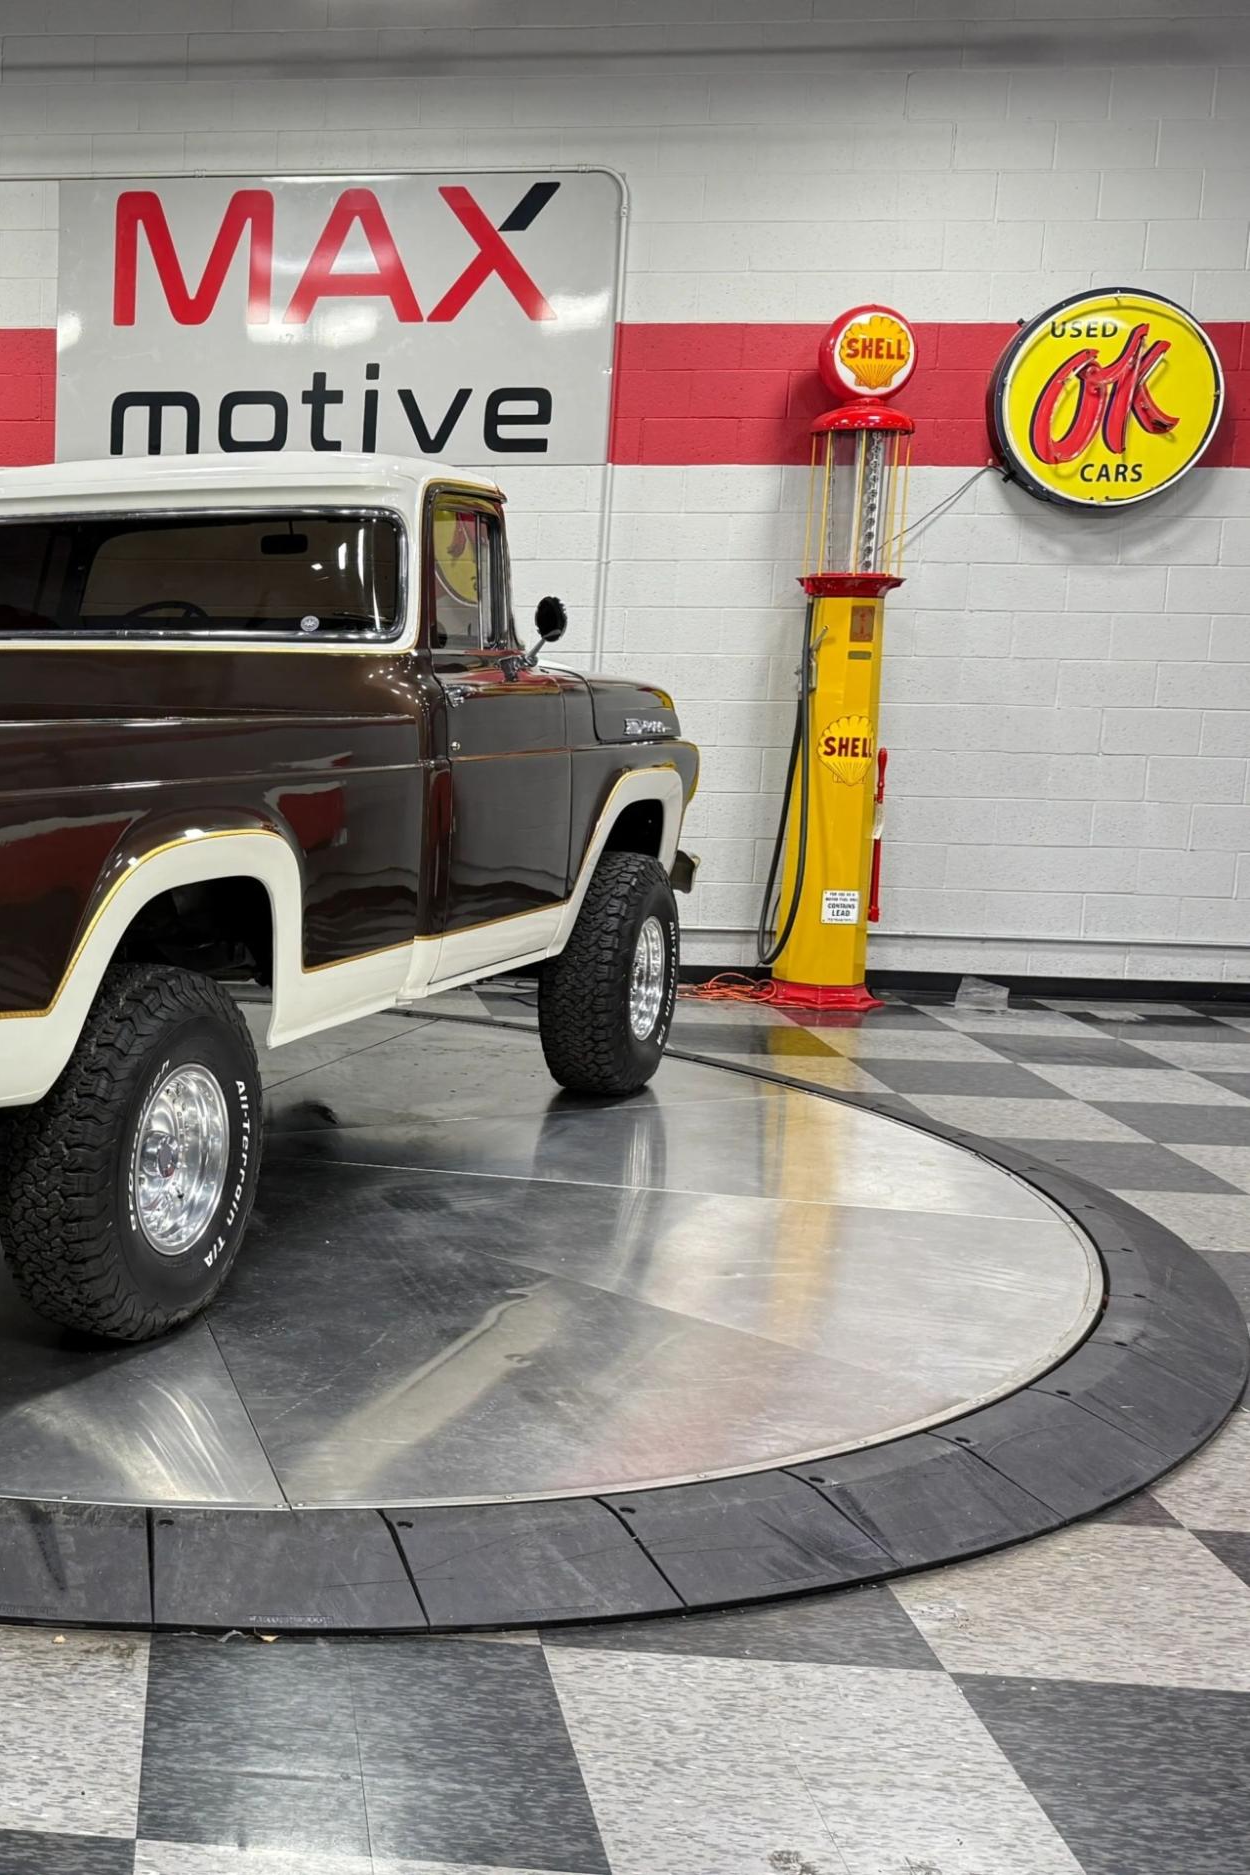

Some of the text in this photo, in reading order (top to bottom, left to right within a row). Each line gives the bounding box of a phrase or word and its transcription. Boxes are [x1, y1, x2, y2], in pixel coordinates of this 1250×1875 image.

[113, 181, 561, 326] MAX
[845, 337, 905, 361] SHELL
[1051, 320, 1118, 338] USED
[110, 363, 552, 455] motive
[1030, 323, 1180, 464] OK
[1080, 463, 1143, 482] CARS
[823, 736, 872, 759] SHELL
[203, 1080, 250, 1268] All-Terrain T/A
